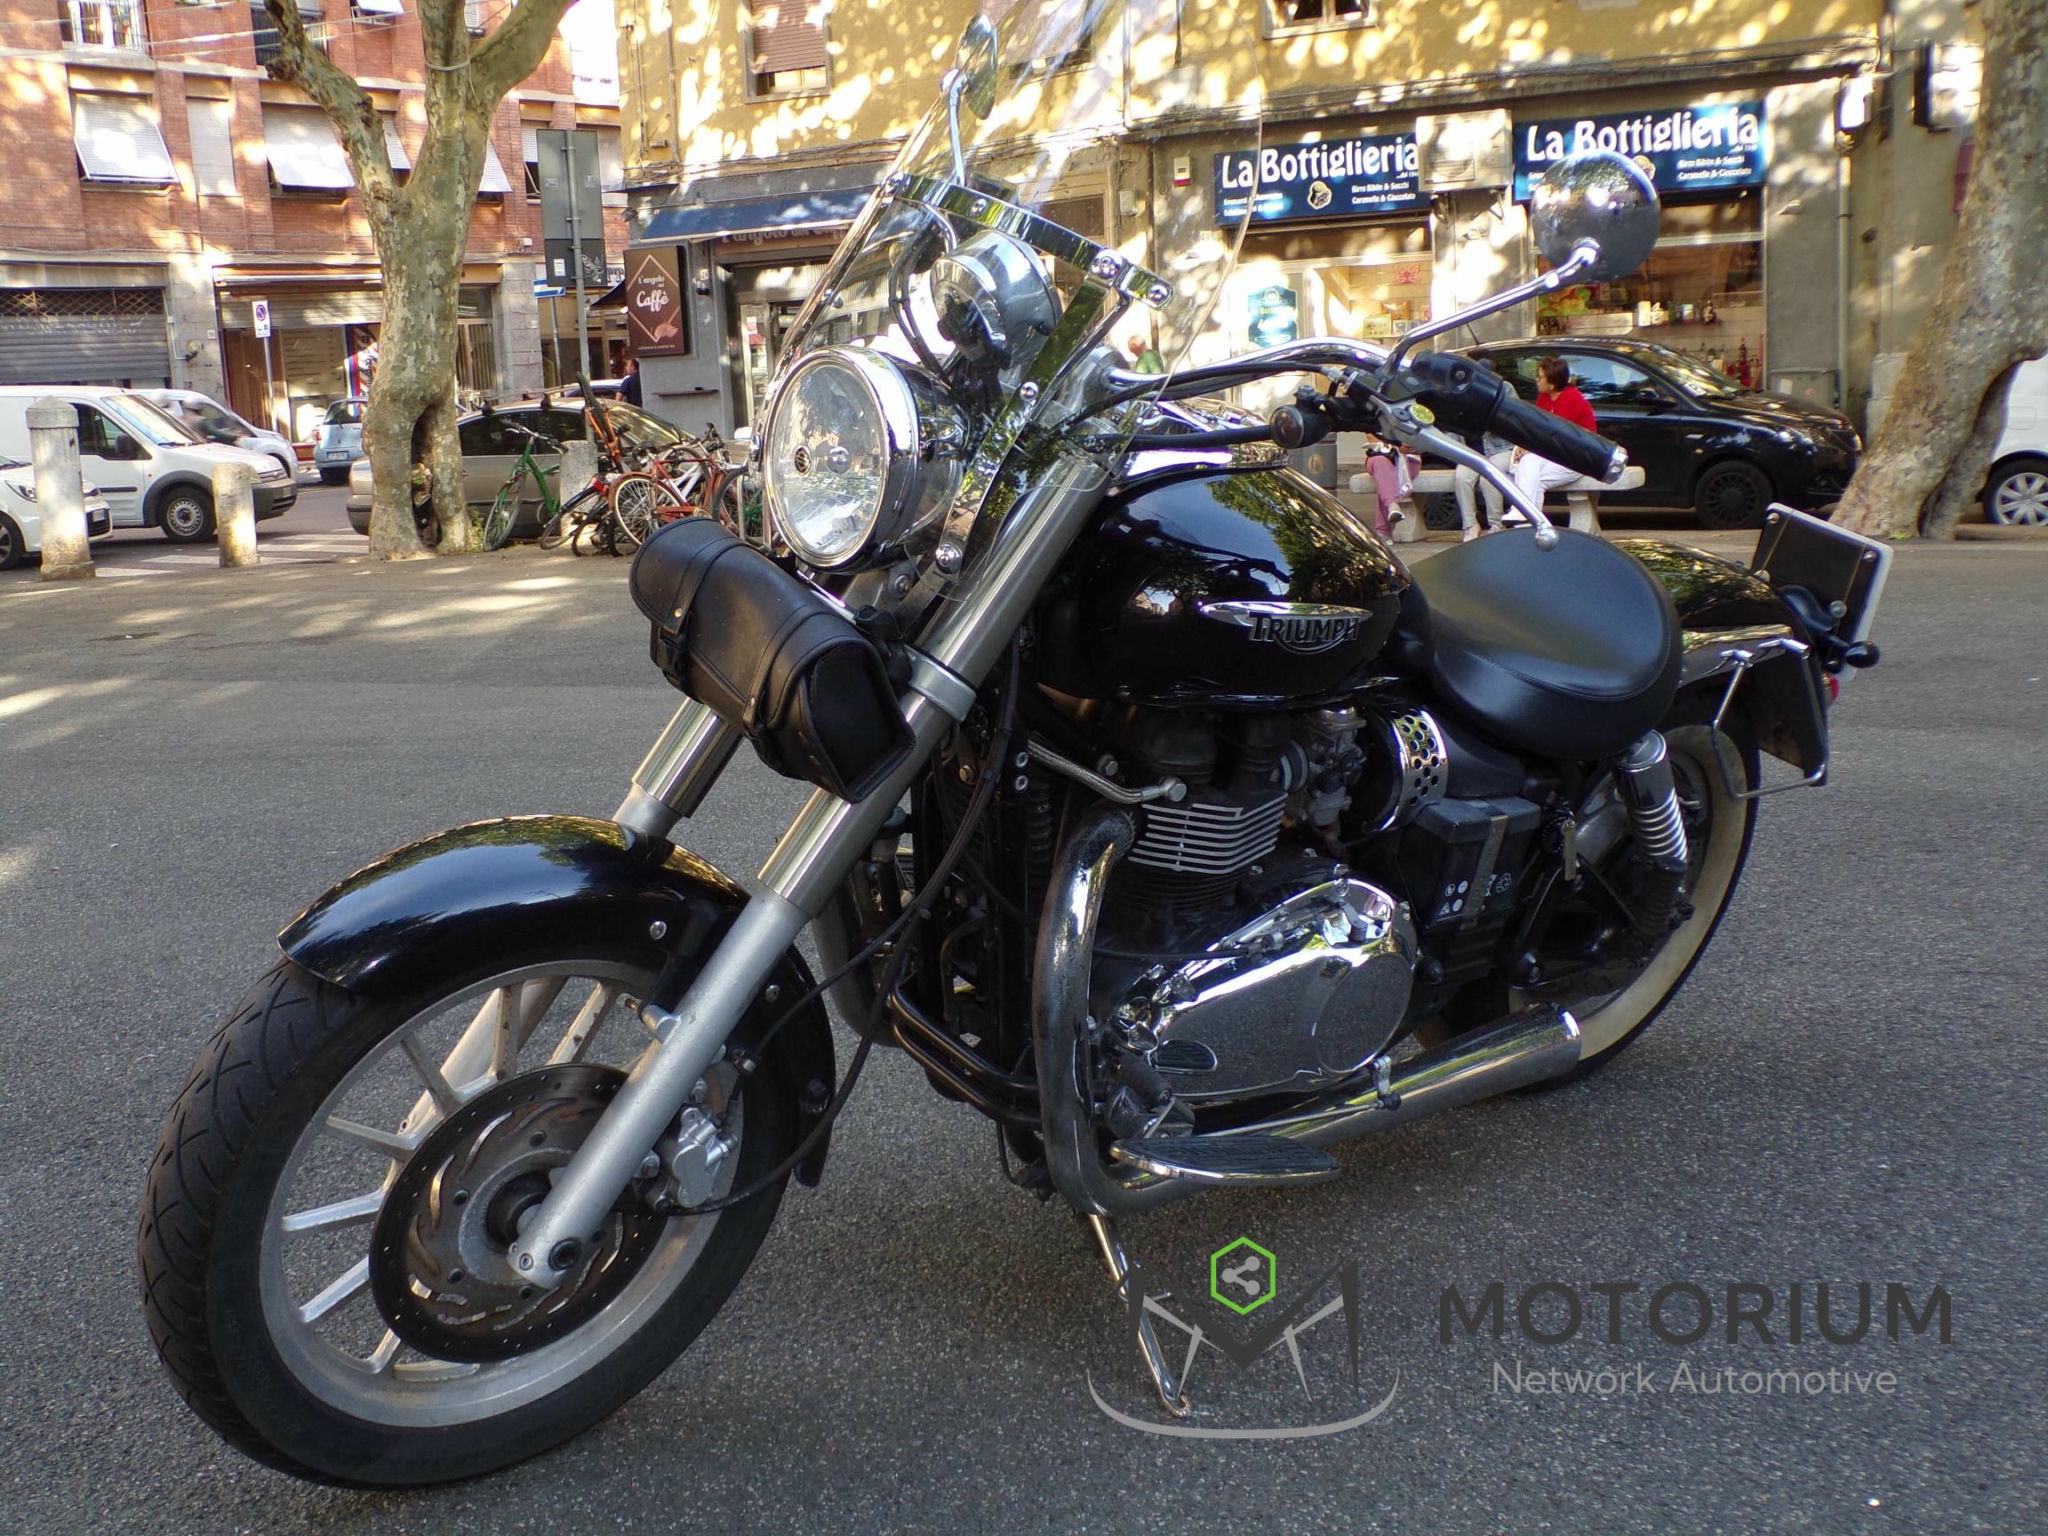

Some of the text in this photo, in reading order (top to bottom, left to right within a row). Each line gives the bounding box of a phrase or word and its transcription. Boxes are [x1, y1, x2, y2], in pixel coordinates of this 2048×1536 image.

[1527, 107, 1759, 161] La Bottiglieria
[1222, 136, 1419, 188] La Bottiglieria
[636, 289, 670, 312] Caffè
[1250, 612, 1360, 648] TRIUMPH
